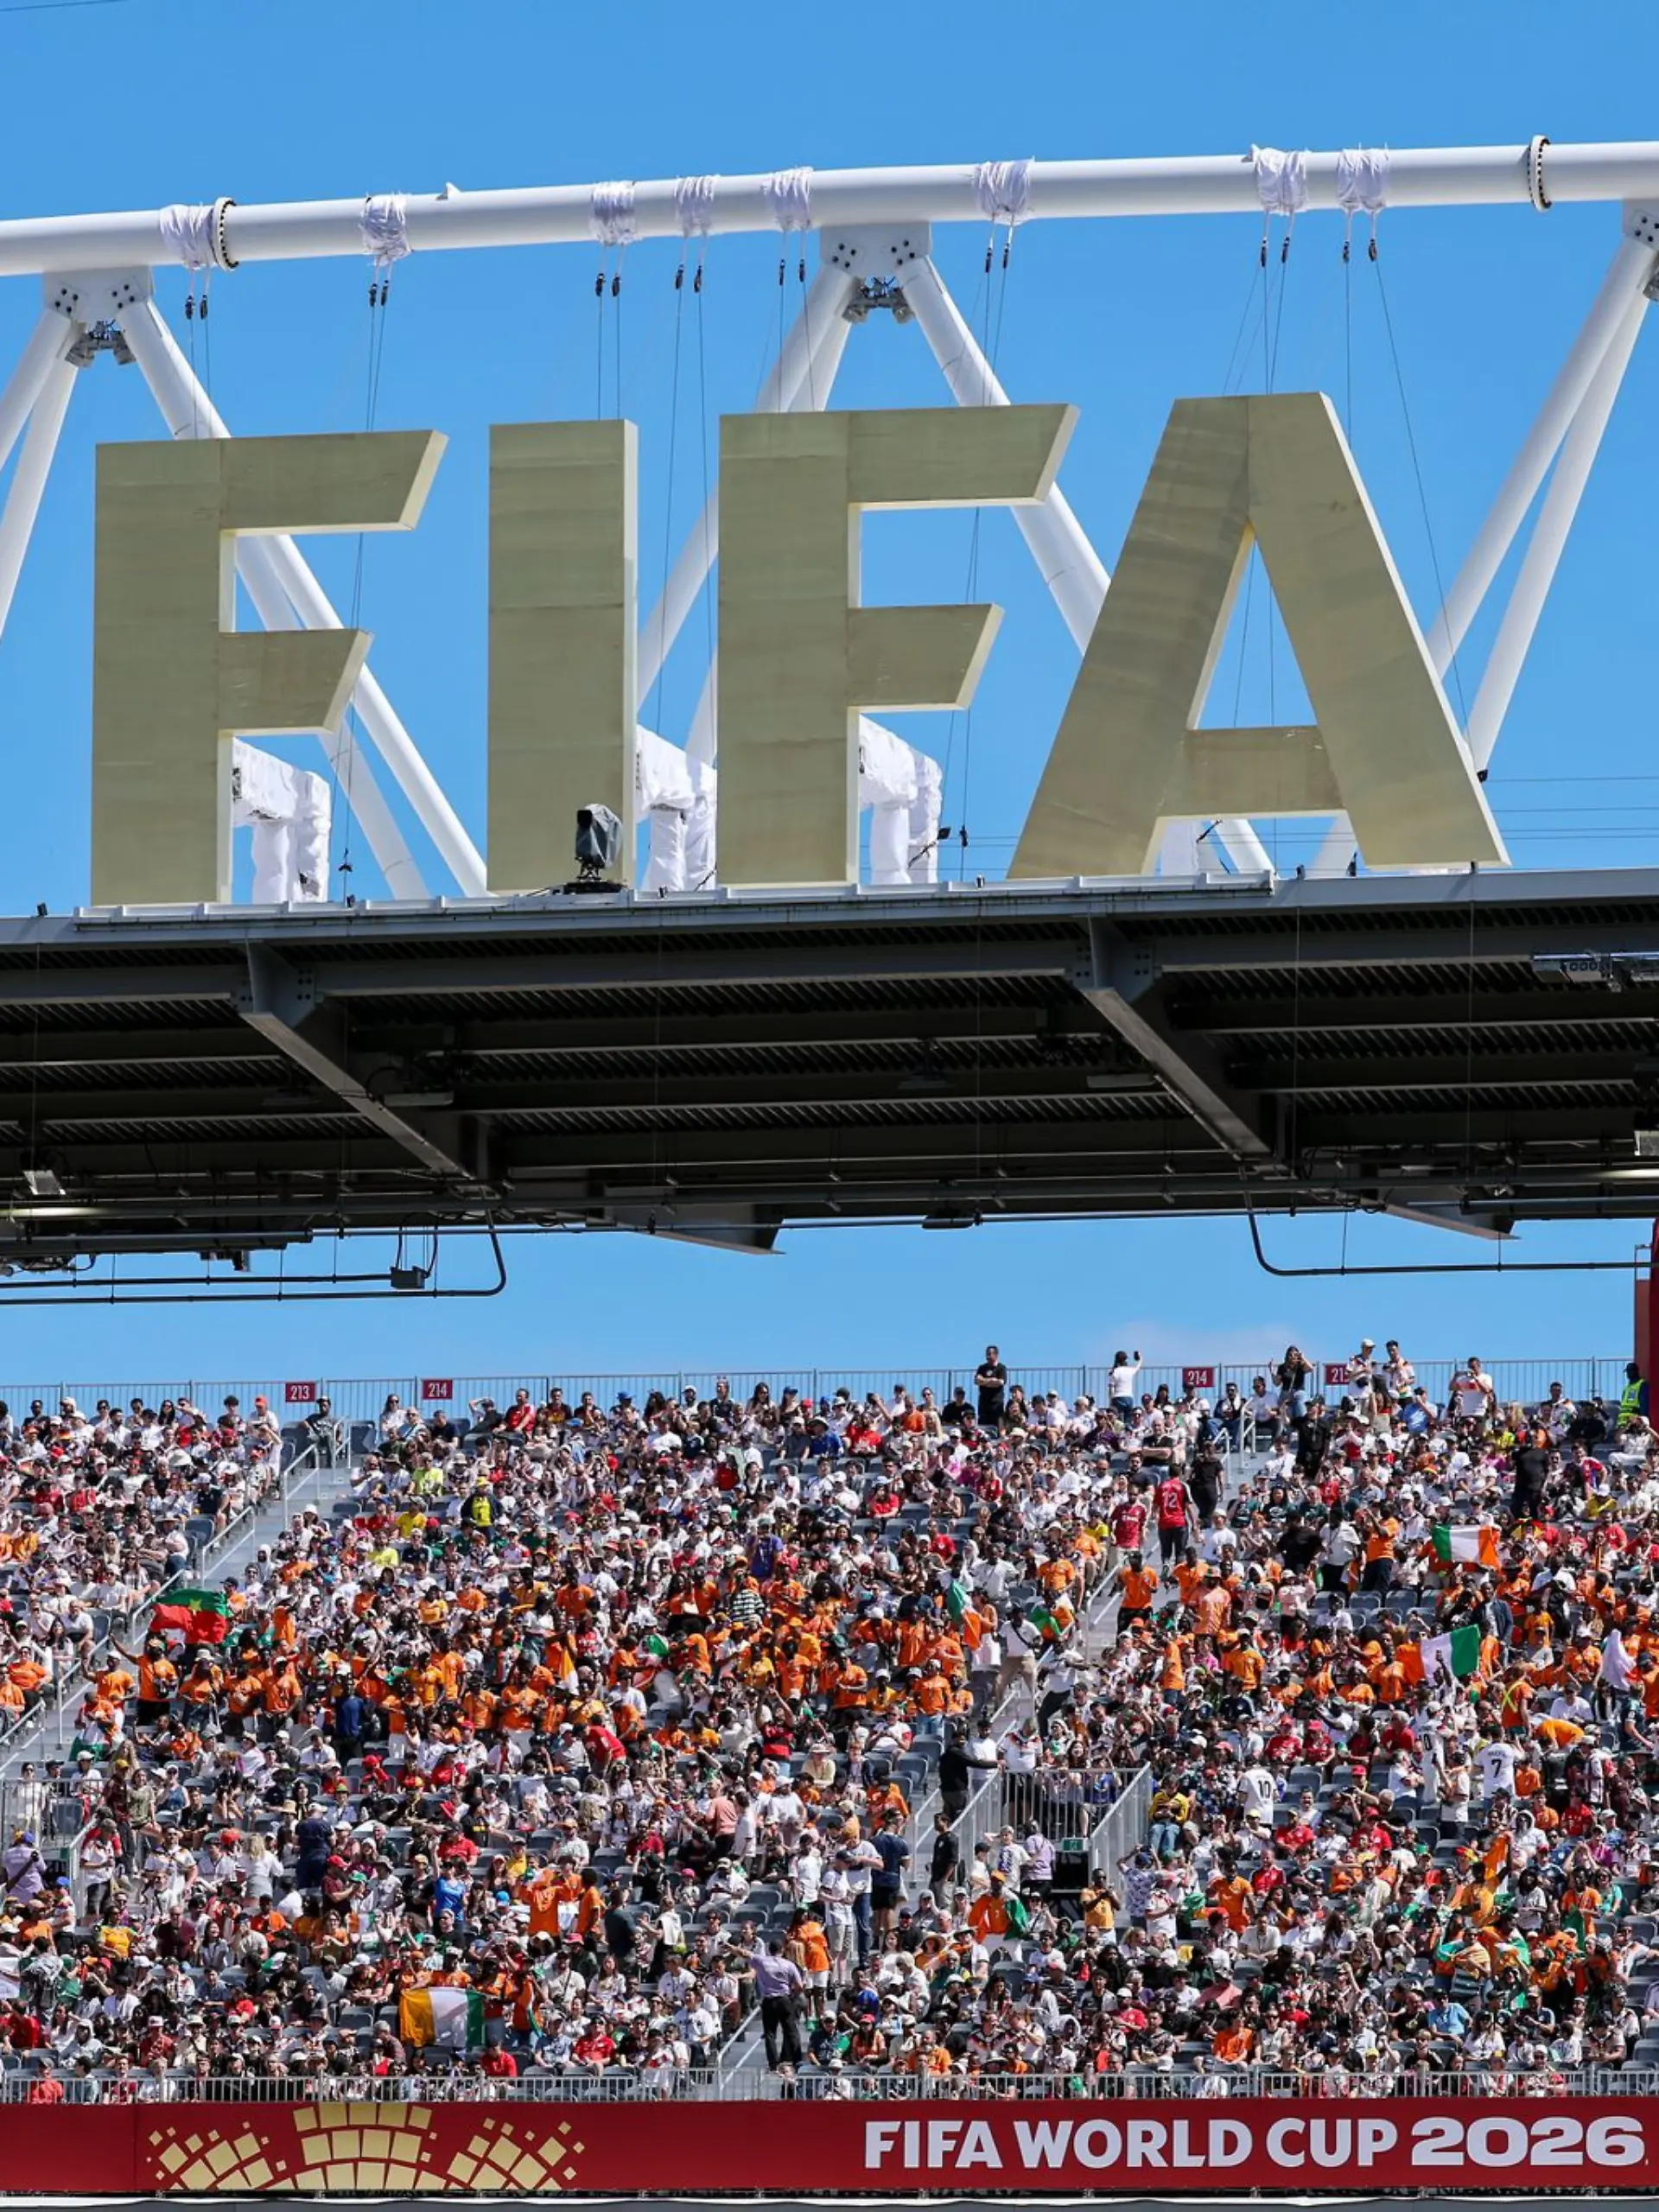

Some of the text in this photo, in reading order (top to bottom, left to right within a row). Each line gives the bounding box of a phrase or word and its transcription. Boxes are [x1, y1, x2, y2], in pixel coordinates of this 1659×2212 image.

[91, 392, 1510, 906] FIFA
[1188, 1370, 1206, 1386] 214
[290, 1385, 309, 1400] 213
[427, 1382, 446, 1396] 214
[1491, 1759, 1503, 1778] 7
[1258, 1780, 1270, 1797] 10
[864, 2116, 1645, 2169] FIFA WORLD CUP 2026
